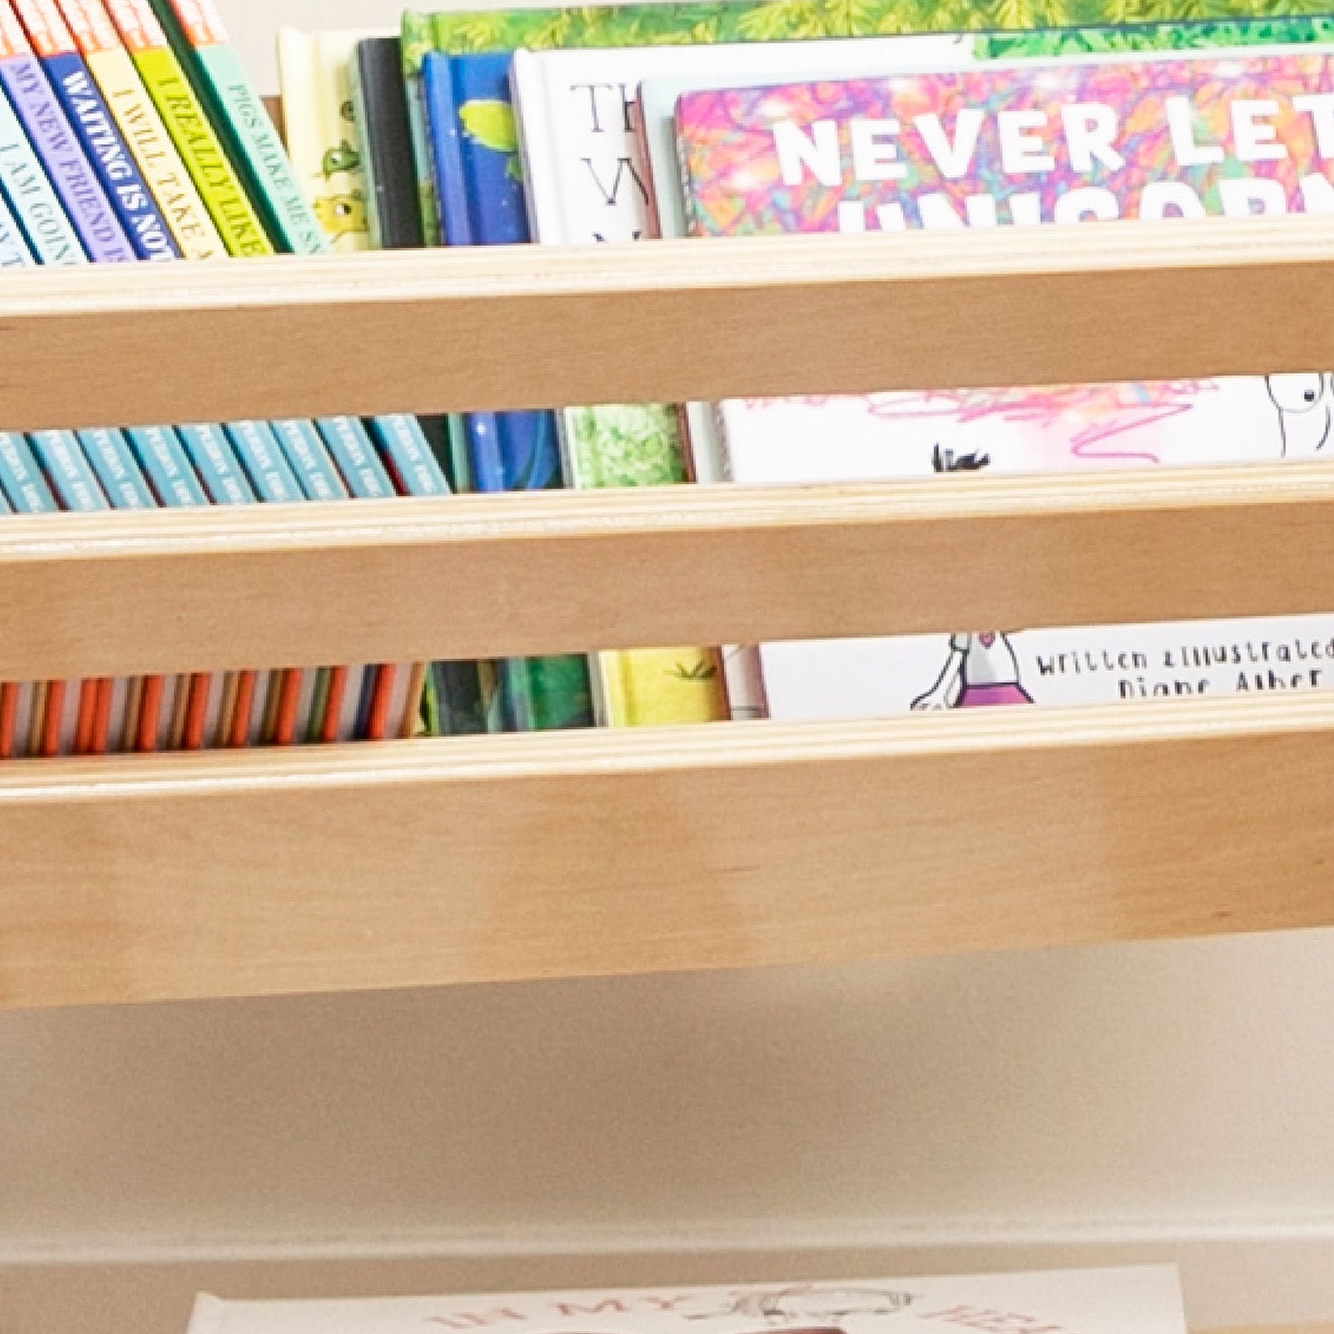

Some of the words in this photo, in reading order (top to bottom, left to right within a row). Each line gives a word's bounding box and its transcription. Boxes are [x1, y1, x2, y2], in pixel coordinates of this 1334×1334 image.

[7, 161, 41, 195] AM
[12, 62, 44, 94] MY
[30, 100, 74, 152] NEW
[59, 158, 116, 242] FRIEND
[63, 70, 133, 181] WAITING
[117, 184, 149, 211] IS
[123, 103, 166, 167] WILL
[158, 172, 206, 240] TAKE
[166, 94, 233, 189] REALLY
[218, 196, 267, 255] LIKE
[229, 83, 263, 128] PIGS
[252, 134, 294, 190] MAKE
[281, 196, 310, 225] ME
[772, 101, 1126, 187] NEVER
